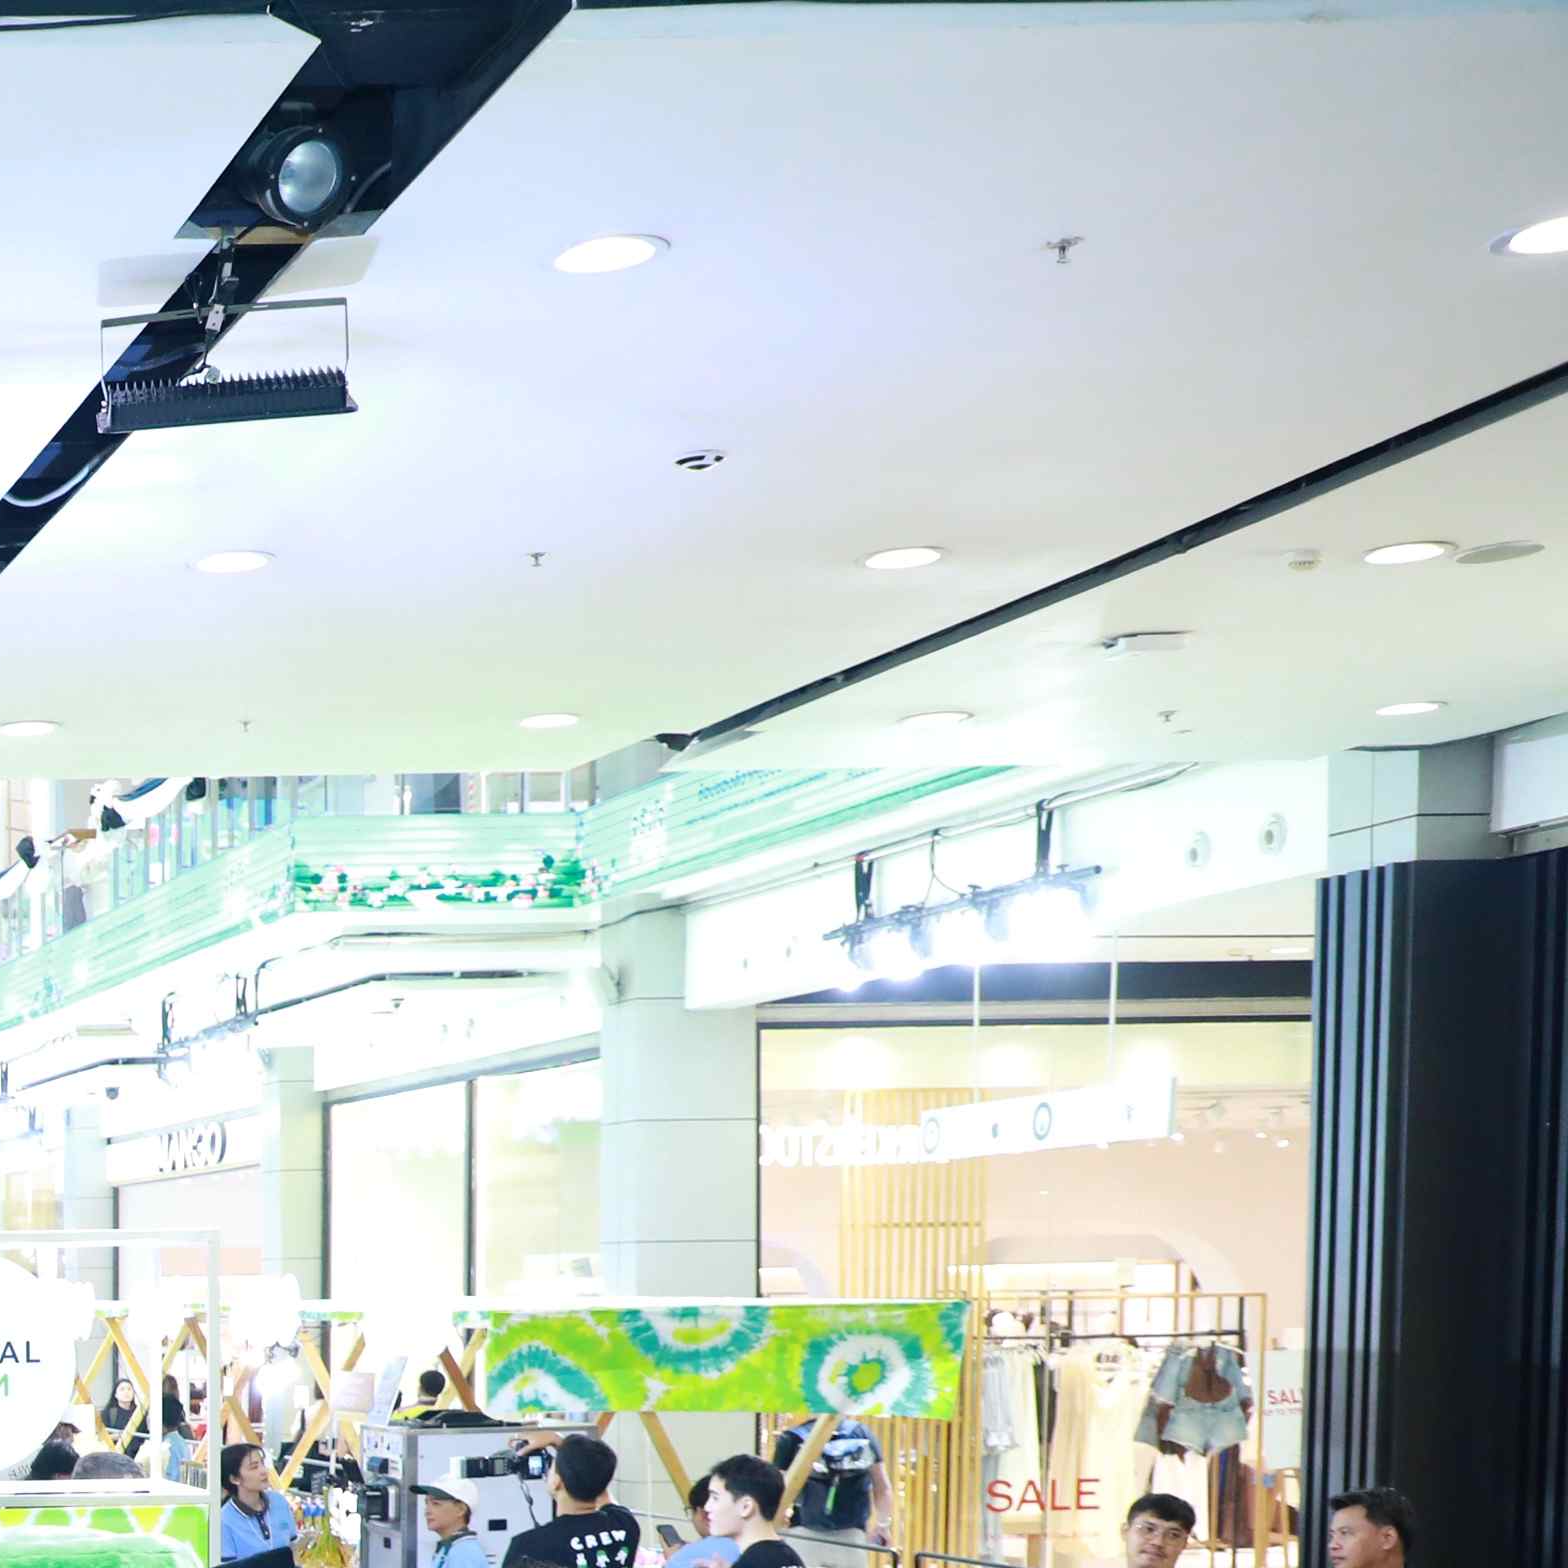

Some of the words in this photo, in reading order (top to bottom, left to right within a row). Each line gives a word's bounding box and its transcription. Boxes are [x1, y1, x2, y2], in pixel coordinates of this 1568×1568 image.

[1267, 1389, 1302, 1404] SAL
[986, 1478, 1100, 1513] SALE
[570, 1530, 627, 1551] CREW
